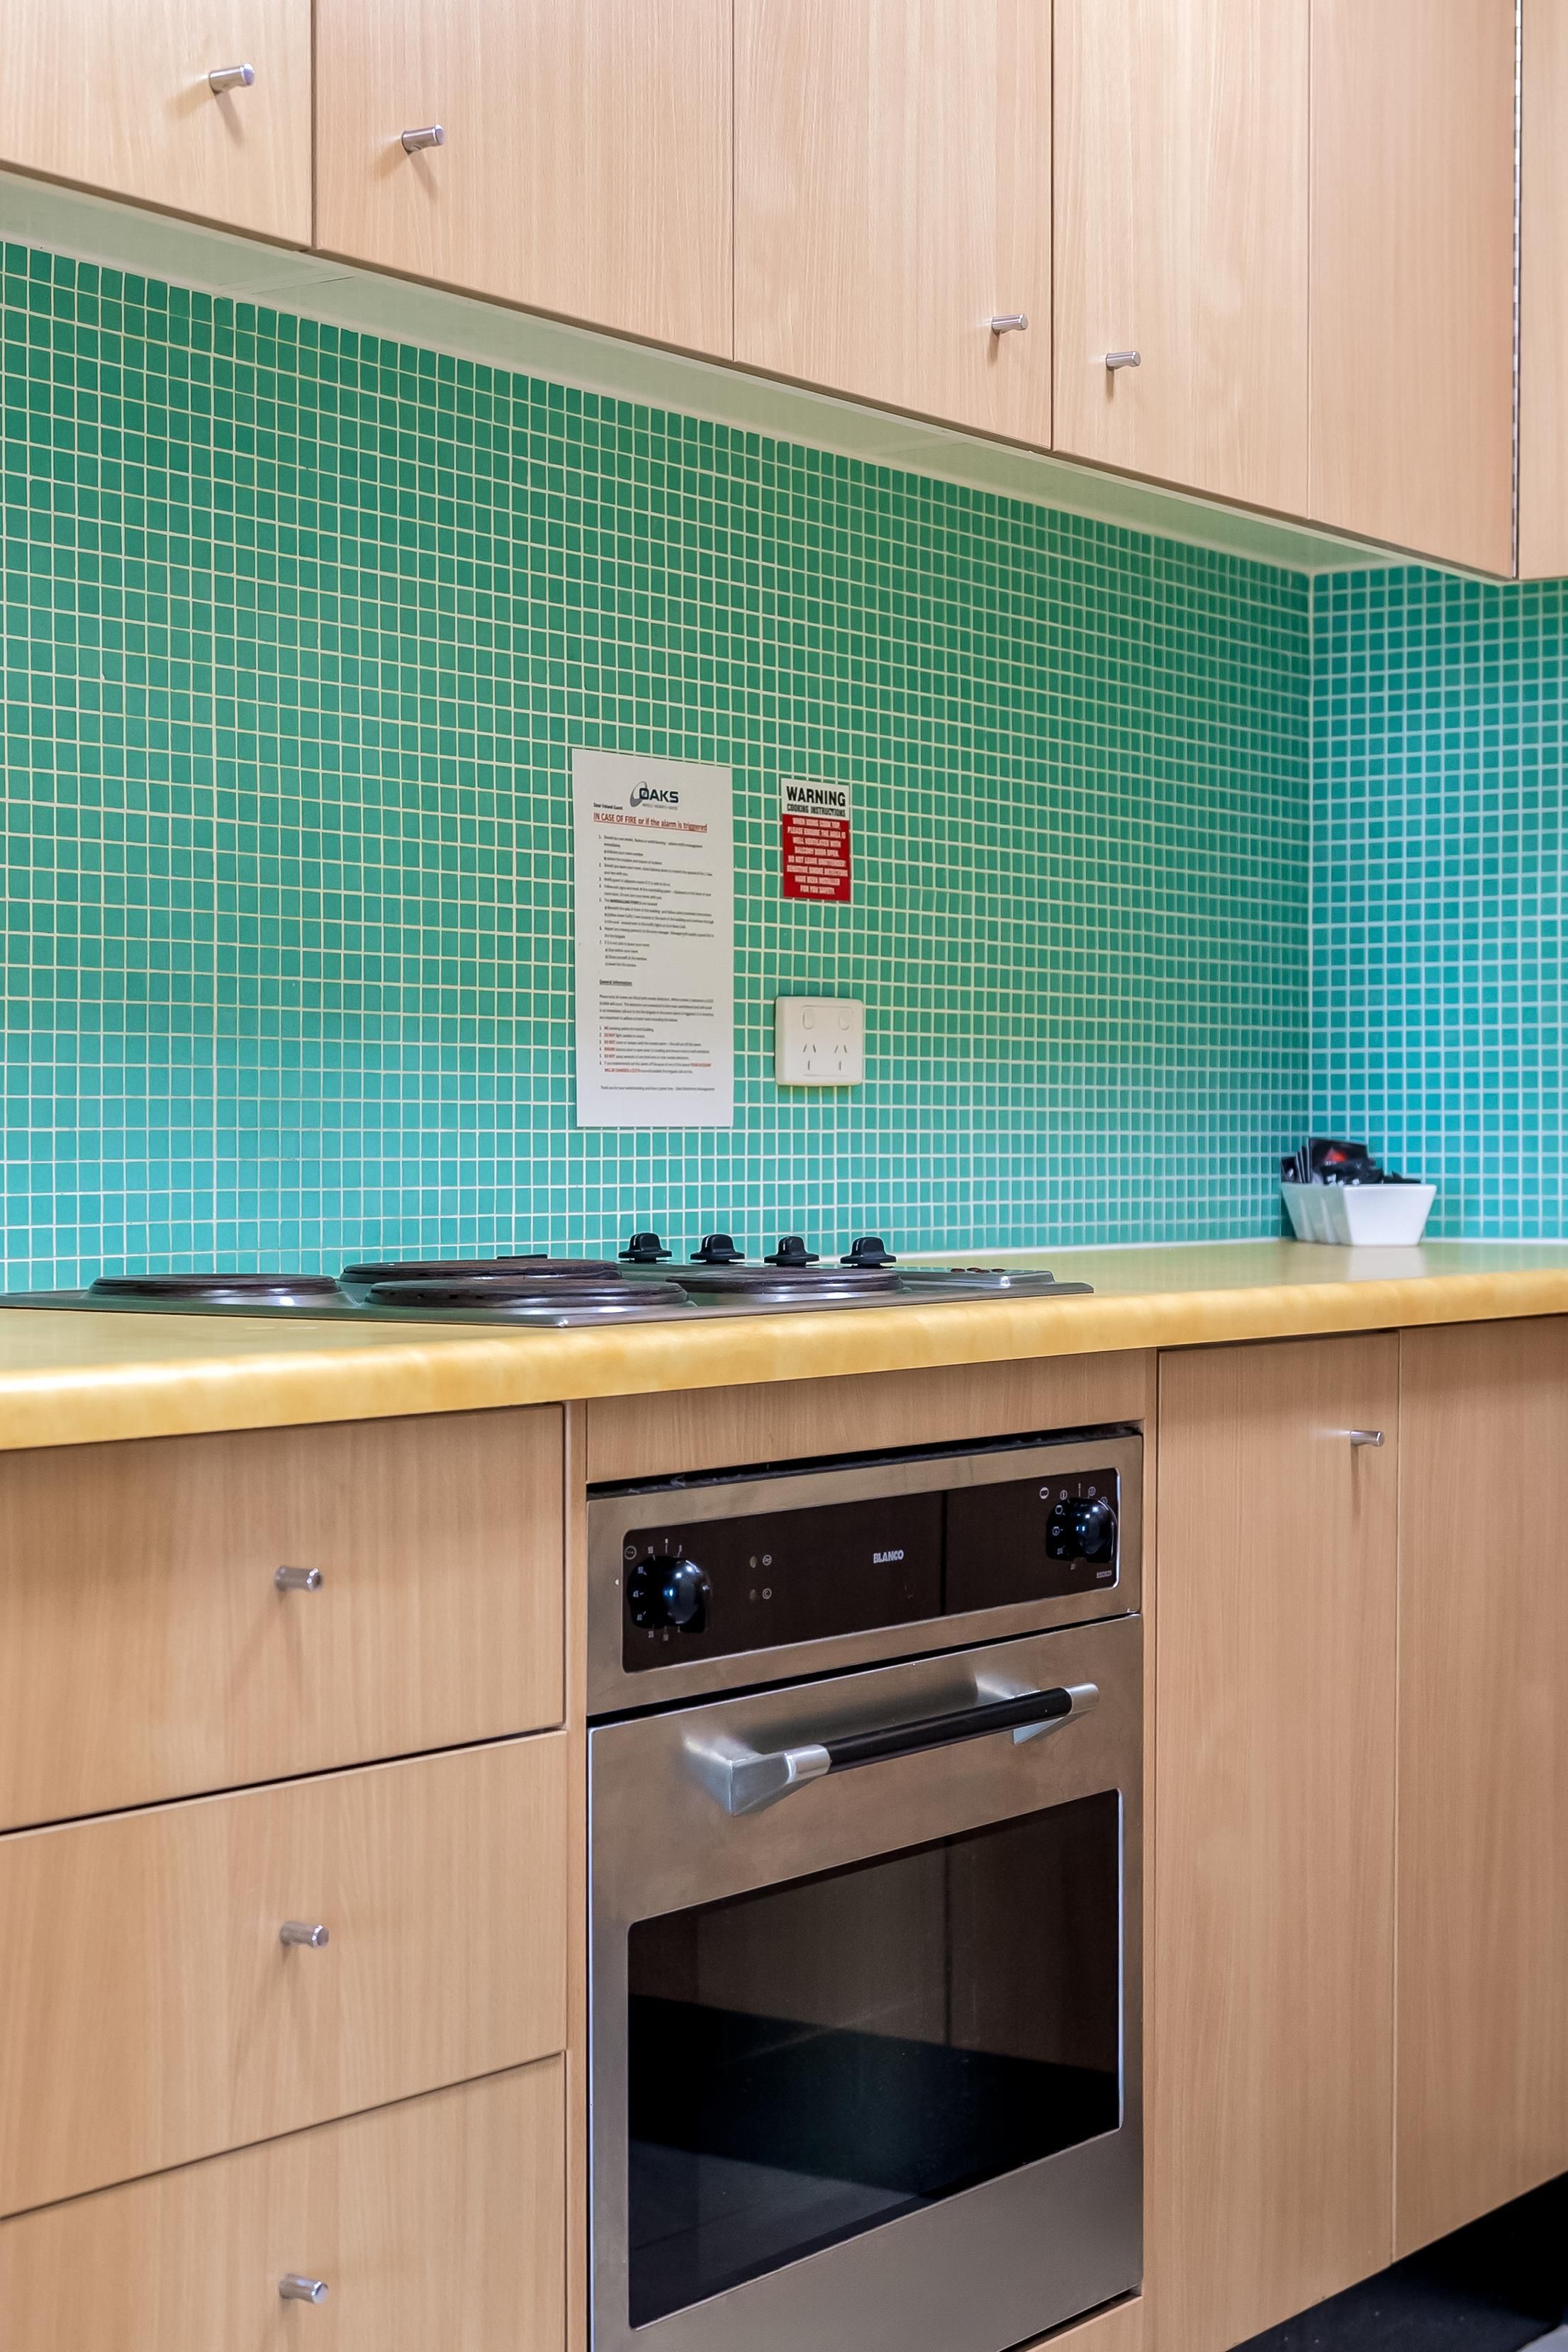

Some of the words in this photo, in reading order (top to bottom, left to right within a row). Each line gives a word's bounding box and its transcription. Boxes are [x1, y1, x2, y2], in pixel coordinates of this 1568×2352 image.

[639, 788, 679, 803] OAKS
[786, 785, 846, 807] WARNING
[787, 803, 809, 813] COOKING
[810, 806, 846, 817] INSTRUCTIONS
[601, 813, 615, 822] CASE
[651, 818, 660, 827] the
[661, 819, 676, 828] alarm
[683, 822, 707, 831] triggered
[873, 1550, 905, 1564] BLANCO
